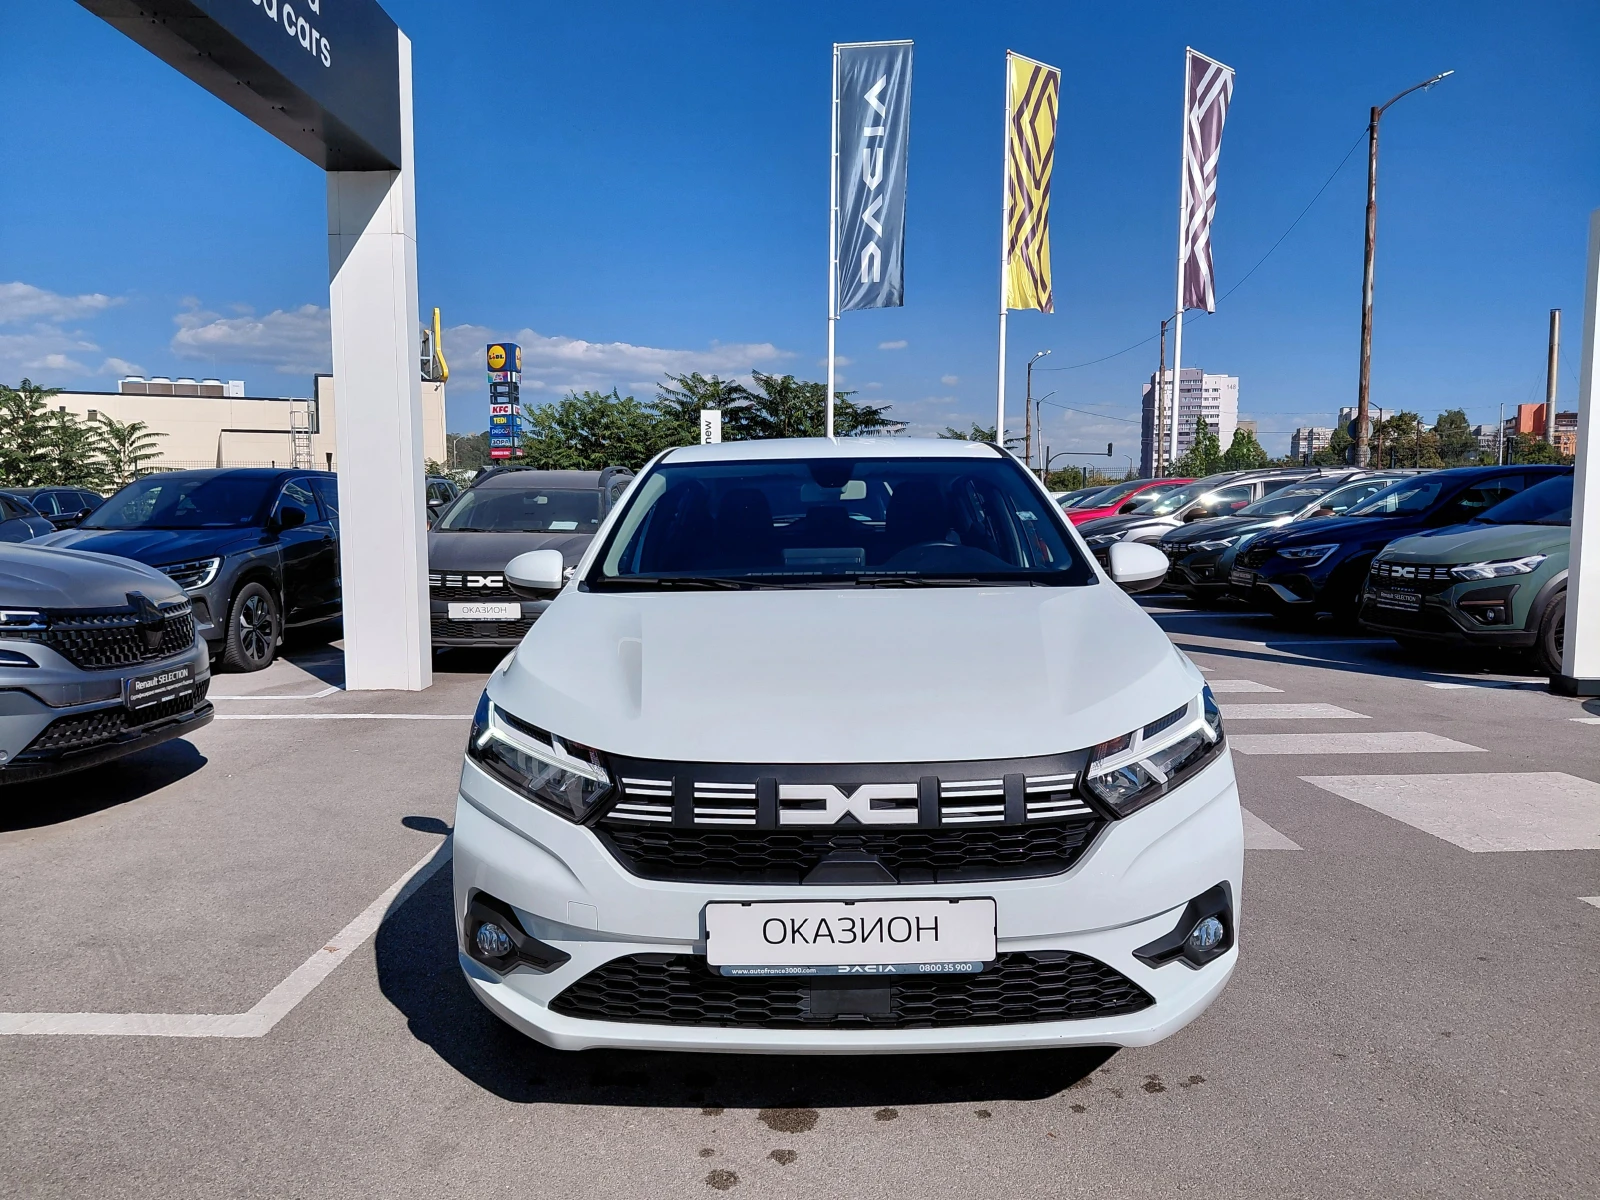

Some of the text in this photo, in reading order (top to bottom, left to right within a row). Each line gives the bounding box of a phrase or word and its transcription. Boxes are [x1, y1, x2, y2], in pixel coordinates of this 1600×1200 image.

[282, 3, 331, 68] cars
[861, 74, 887, 283] DACIA
[492, 405, 509, 414] KFC
[462, 606, 507, 614] ОКАЗИОН
[135, 677, 158, 690] Renault
[158, 669, 188, 684] SELECTION
[762, 915, 939, 945] ОКАЗИОН
[731, 963, 972, 975] www.autofrance3000.com DACIA 0800 35 900
